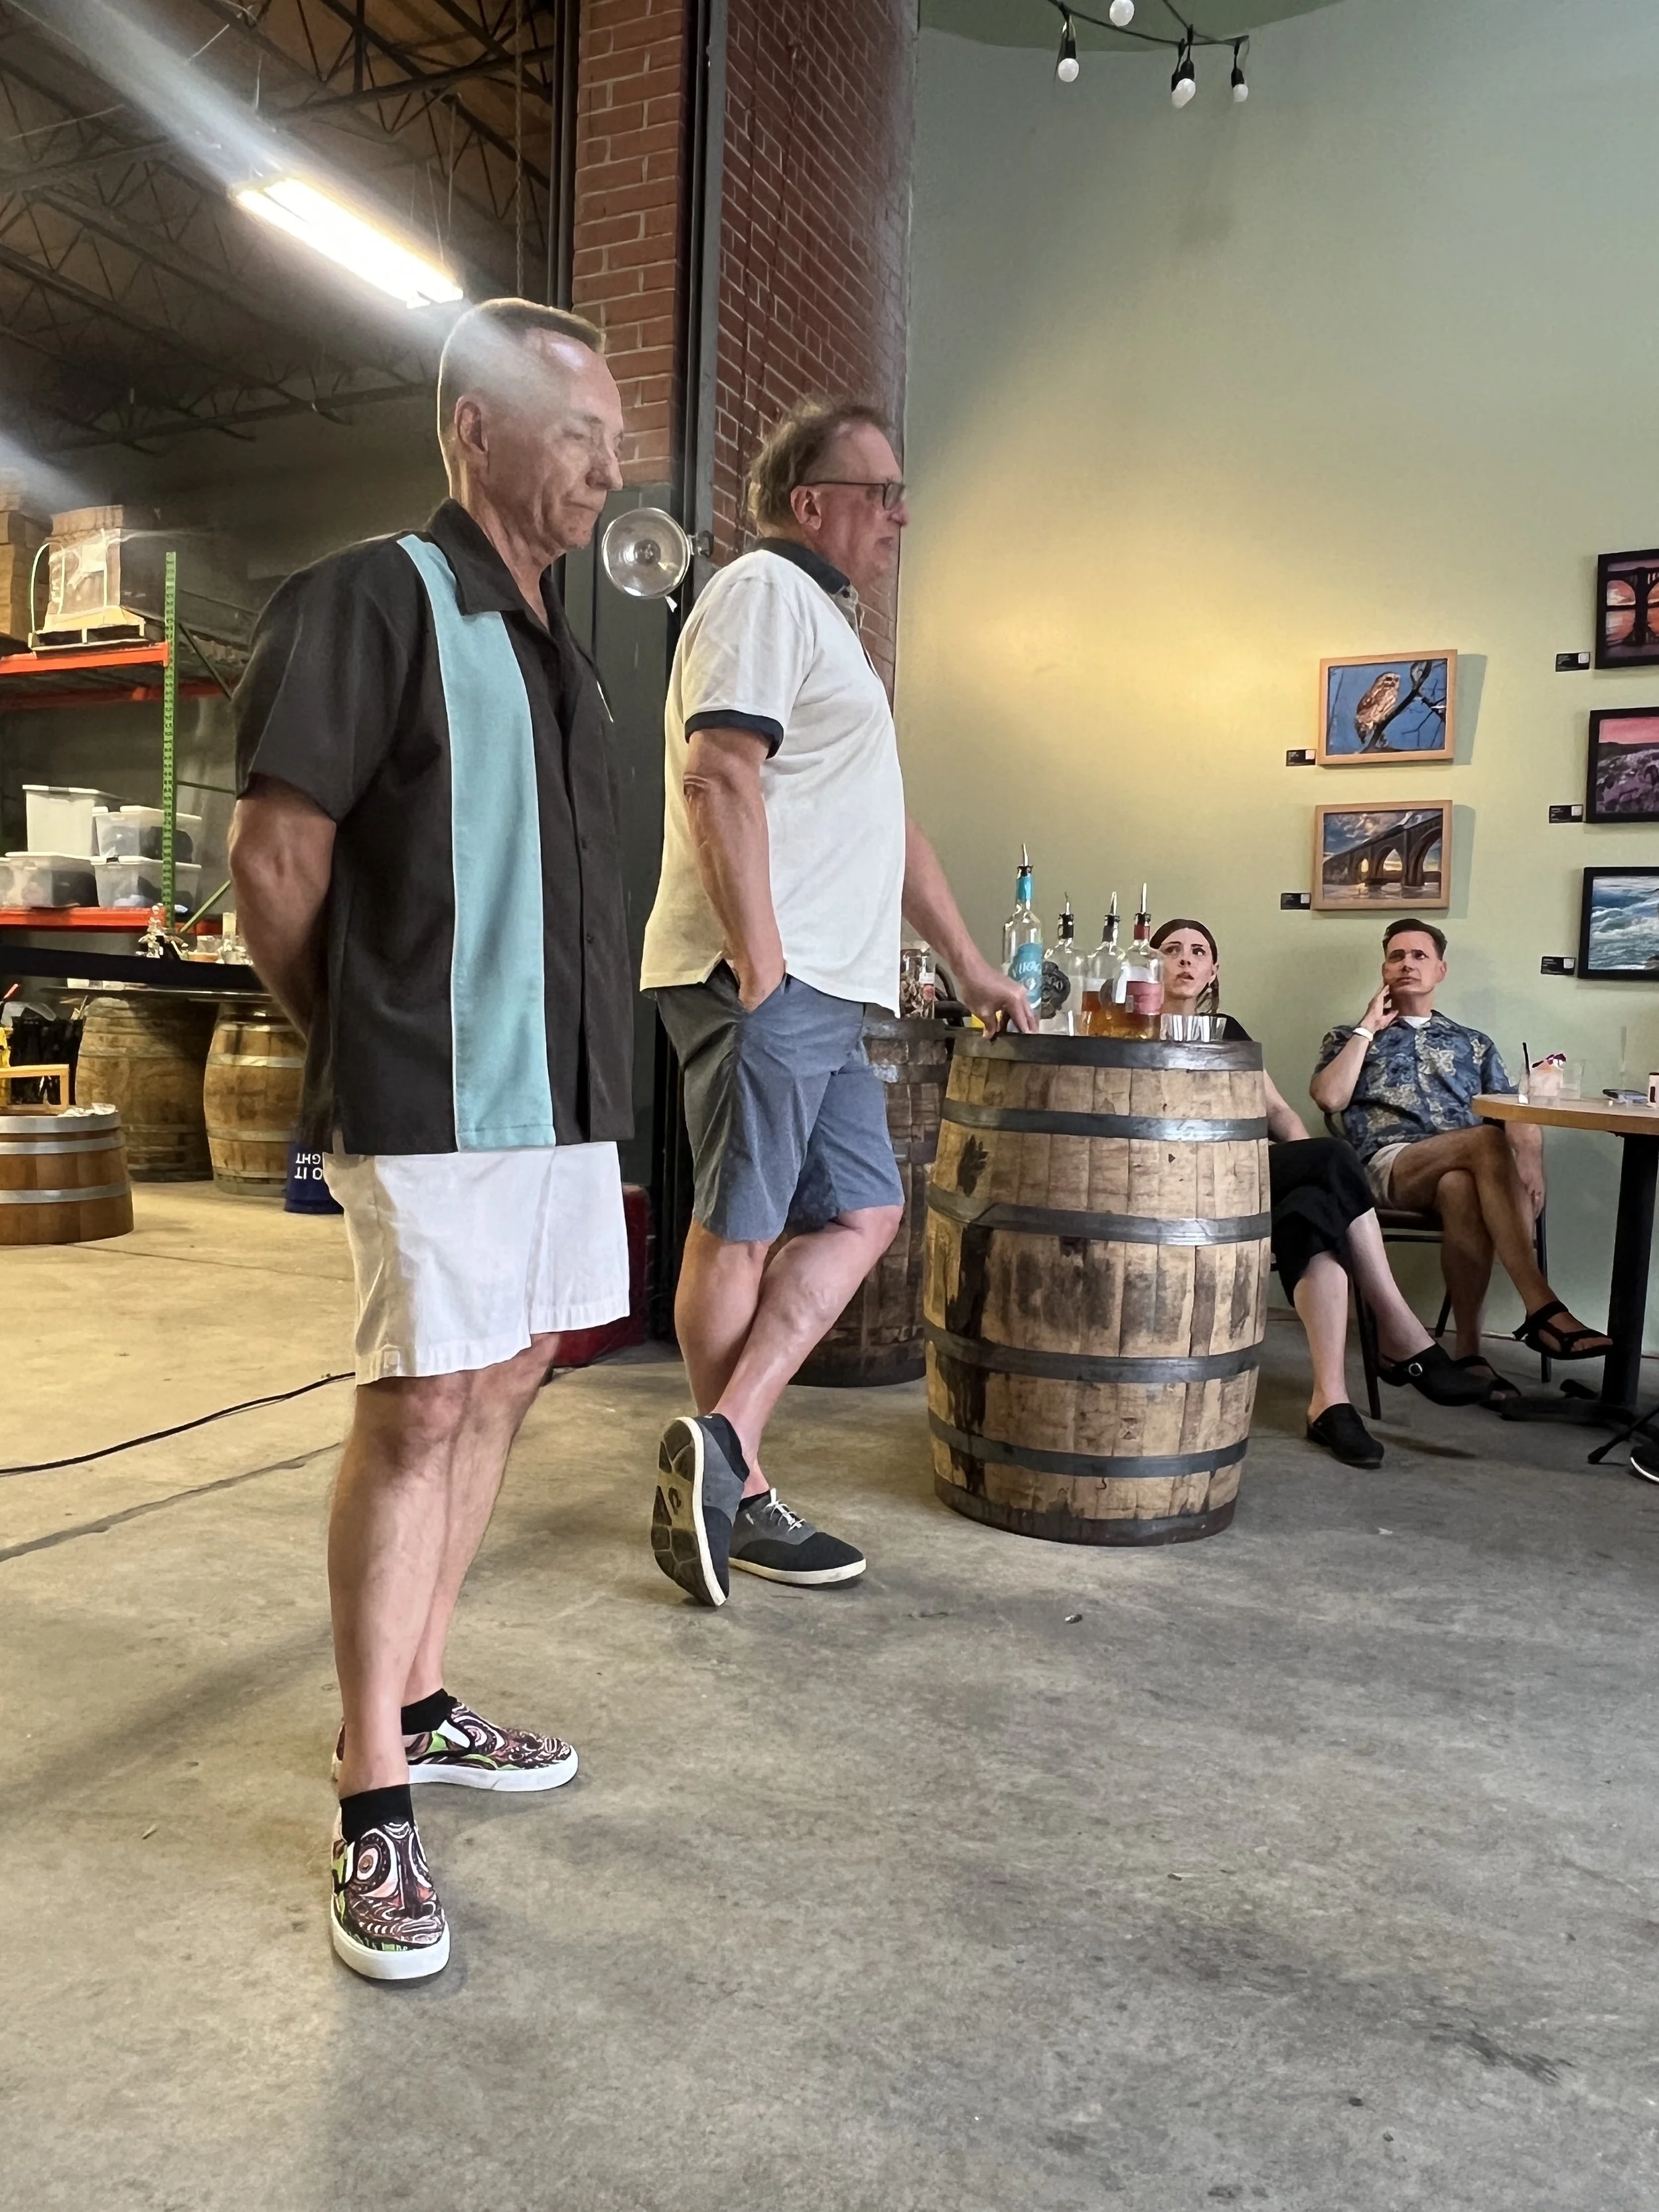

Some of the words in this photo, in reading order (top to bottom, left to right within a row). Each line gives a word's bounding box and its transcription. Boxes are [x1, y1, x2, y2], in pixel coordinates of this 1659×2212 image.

[295, 1152, 321, 1165] GHT
[294, 1166, 307, 1179] IT
[312, 1167, 323, 1180] O
